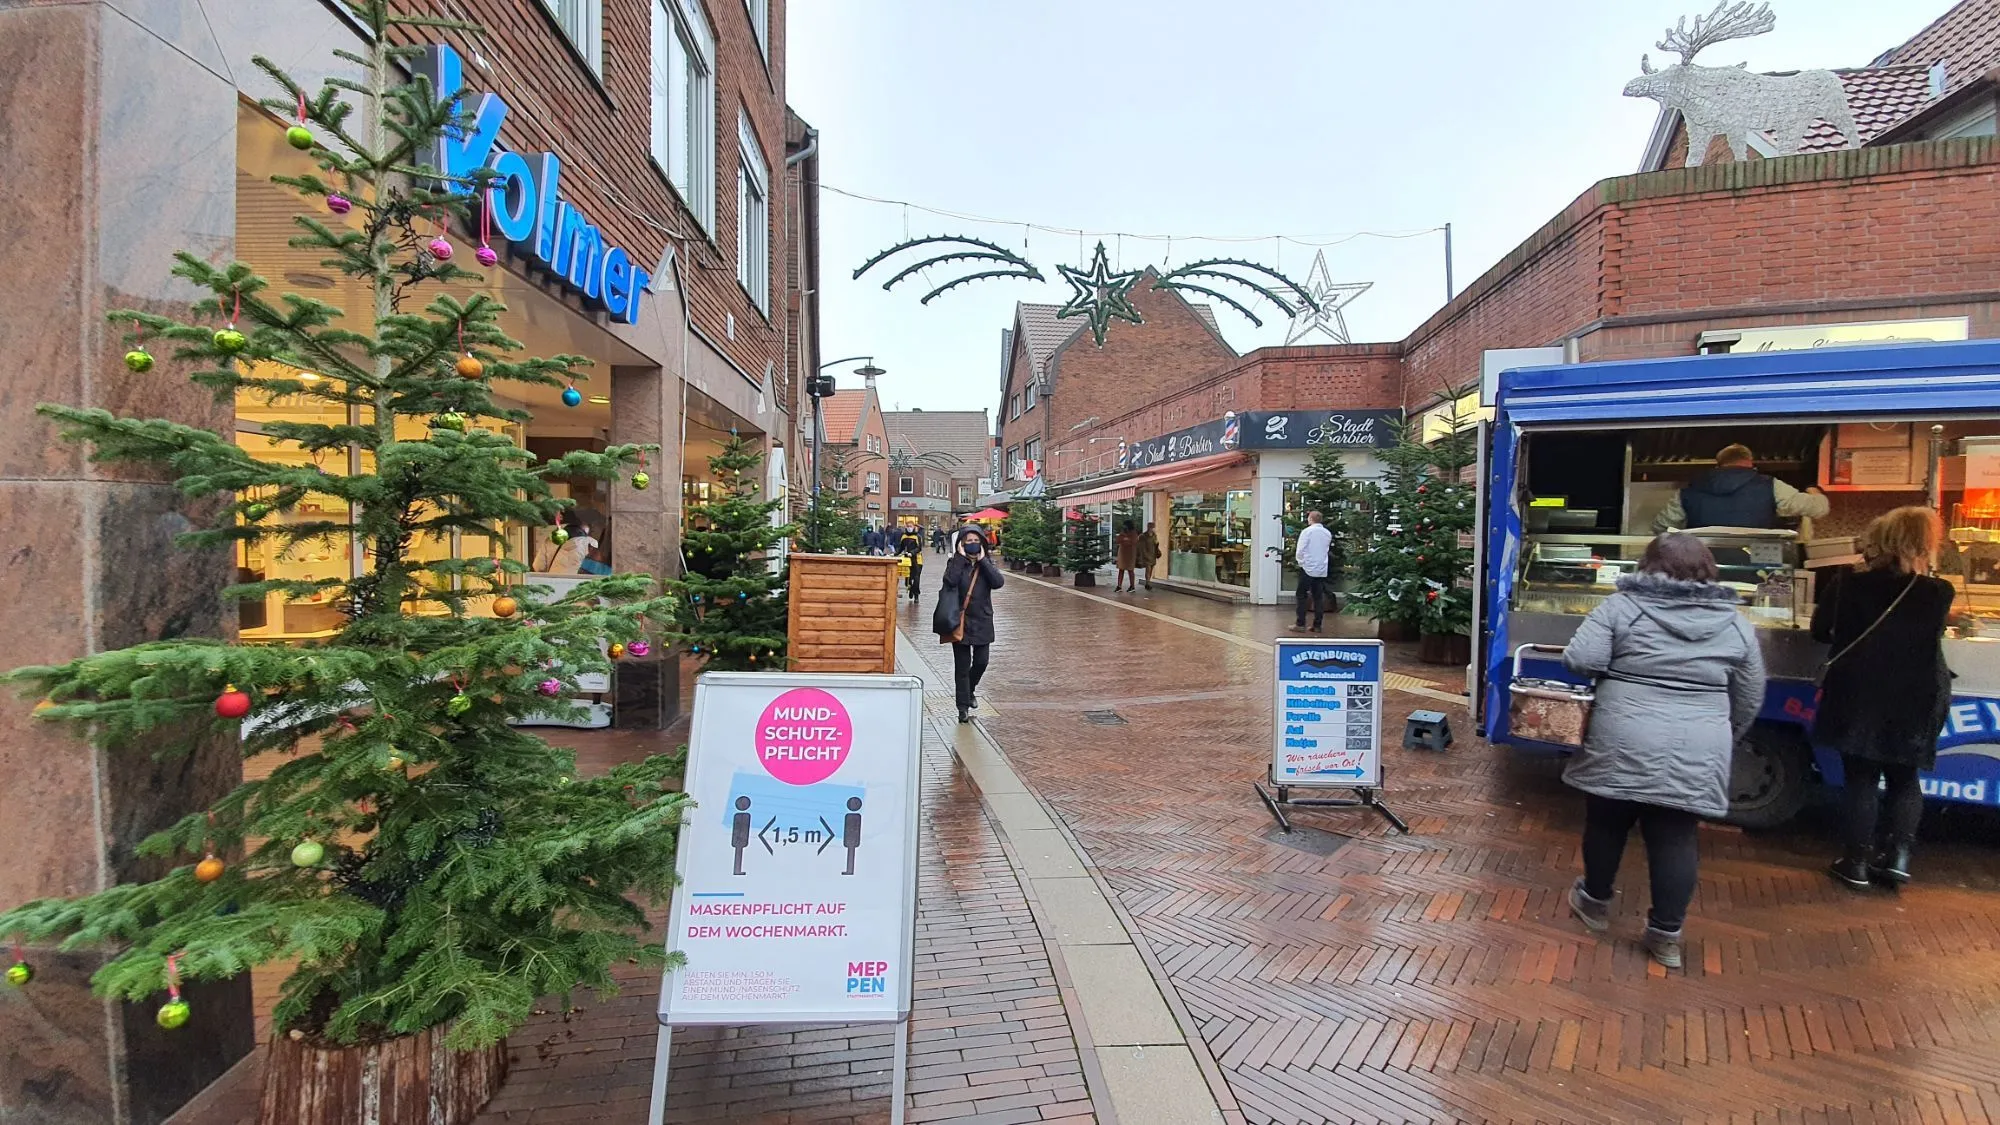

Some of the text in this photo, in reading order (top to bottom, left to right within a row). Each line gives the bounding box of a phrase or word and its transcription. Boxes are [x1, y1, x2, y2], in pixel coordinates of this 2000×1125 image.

[1320, 414, 1374, 434] Stadt
[1306, 428, 1375, 445] Barbier
[1144, 435, 1213, 466] Stadt Barbier
[1291, 650, 1367, 664] MEYENBURG'S
[1300, 671, 1356, 679] Fischhandel
[773, 707, 836, 721] MUND-
[1286, 712, 1321, 721] Forelle
[764, 726, 842, 741] SCHUTZ-
[1285, 725, 1304, 734] Aal
[1285, 738, 1318, 748] Matjes
[764, 746, 841, 761] PFLICHT
[1286, 753, 1304, 763] Wir
[1295, 762, 1321, 776] frisch
[772, 826, 821, 846] 1,5 m
[690, 903, 846, 916] MASKENPFLICHT AUF
[687, 925, 848, 938] DEM WOCHENMARKT.
[848, 961, 888, 977] MEP
[847, 977, 885, 993] PEN
